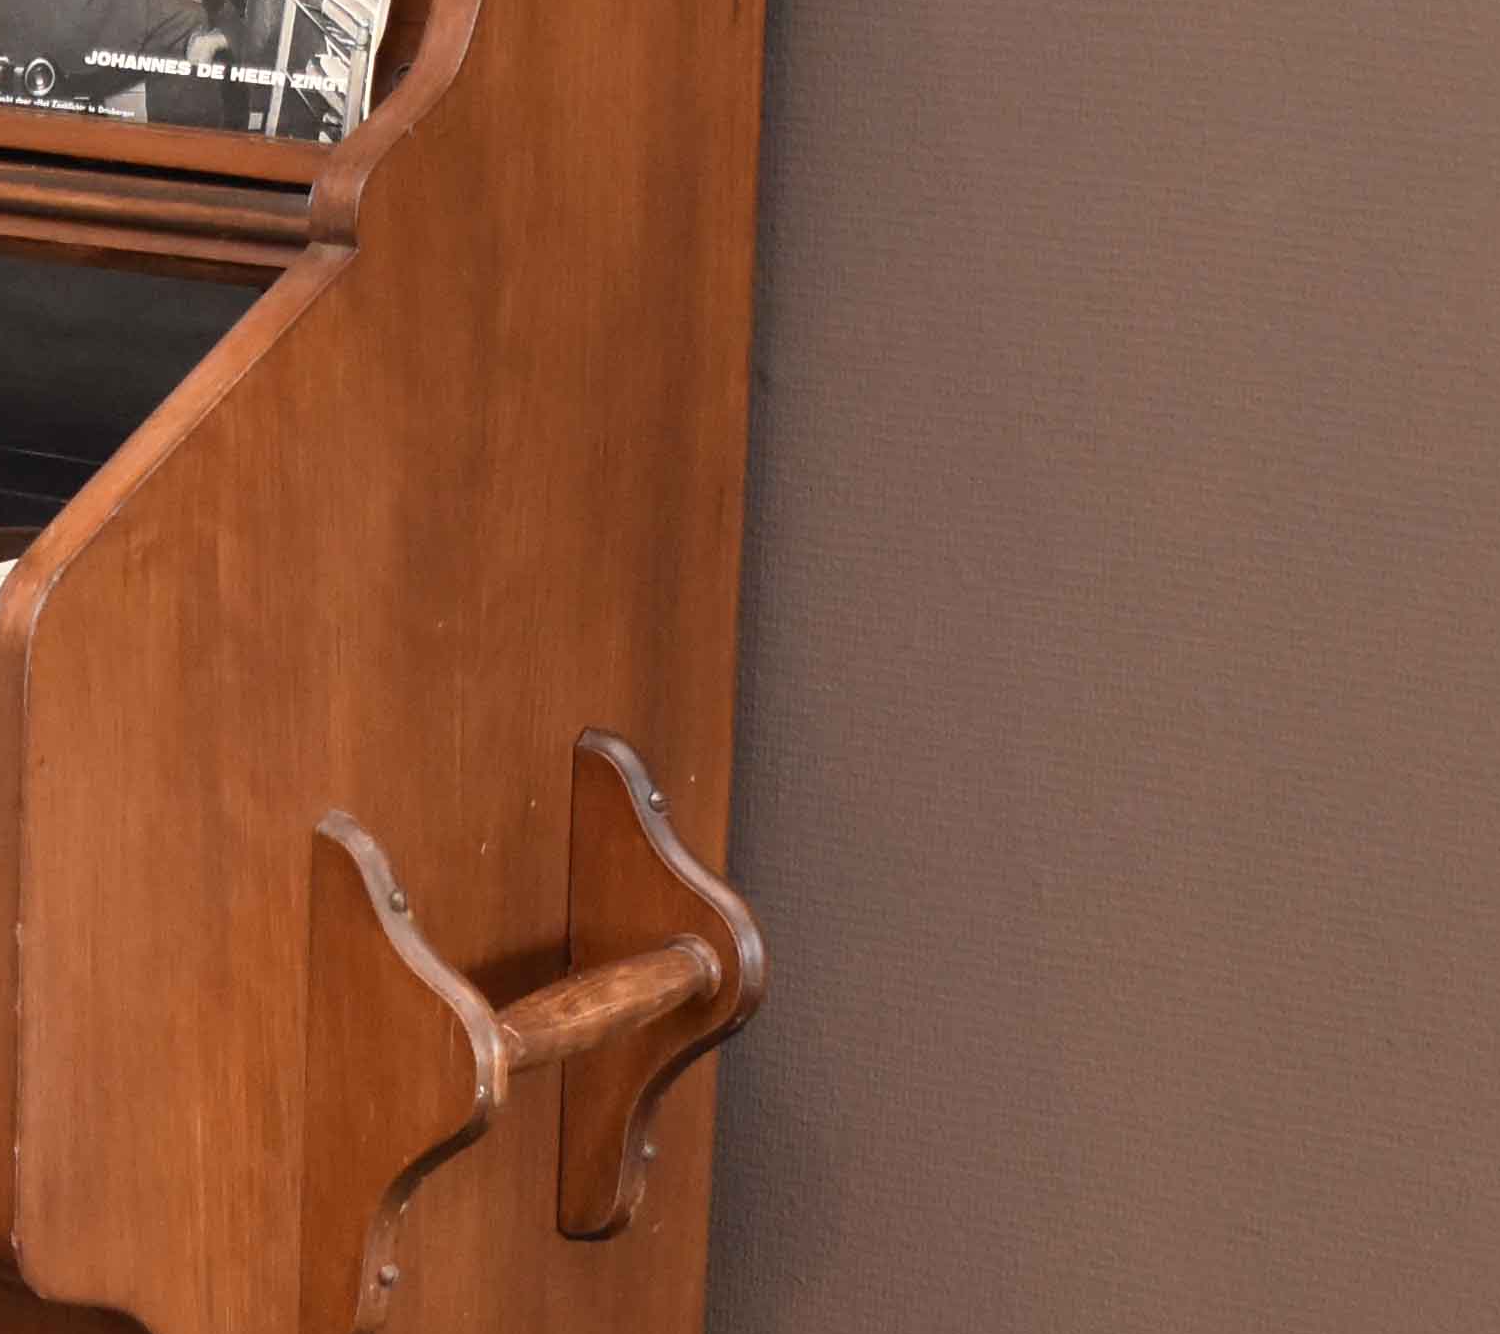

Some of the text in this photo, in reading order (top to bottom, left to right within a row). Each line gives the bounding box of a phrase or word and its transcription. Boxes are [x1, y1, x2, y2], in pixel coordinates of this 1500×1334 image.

[84, 48, 349, 95] JOHANNES DE HEER ZINGT
